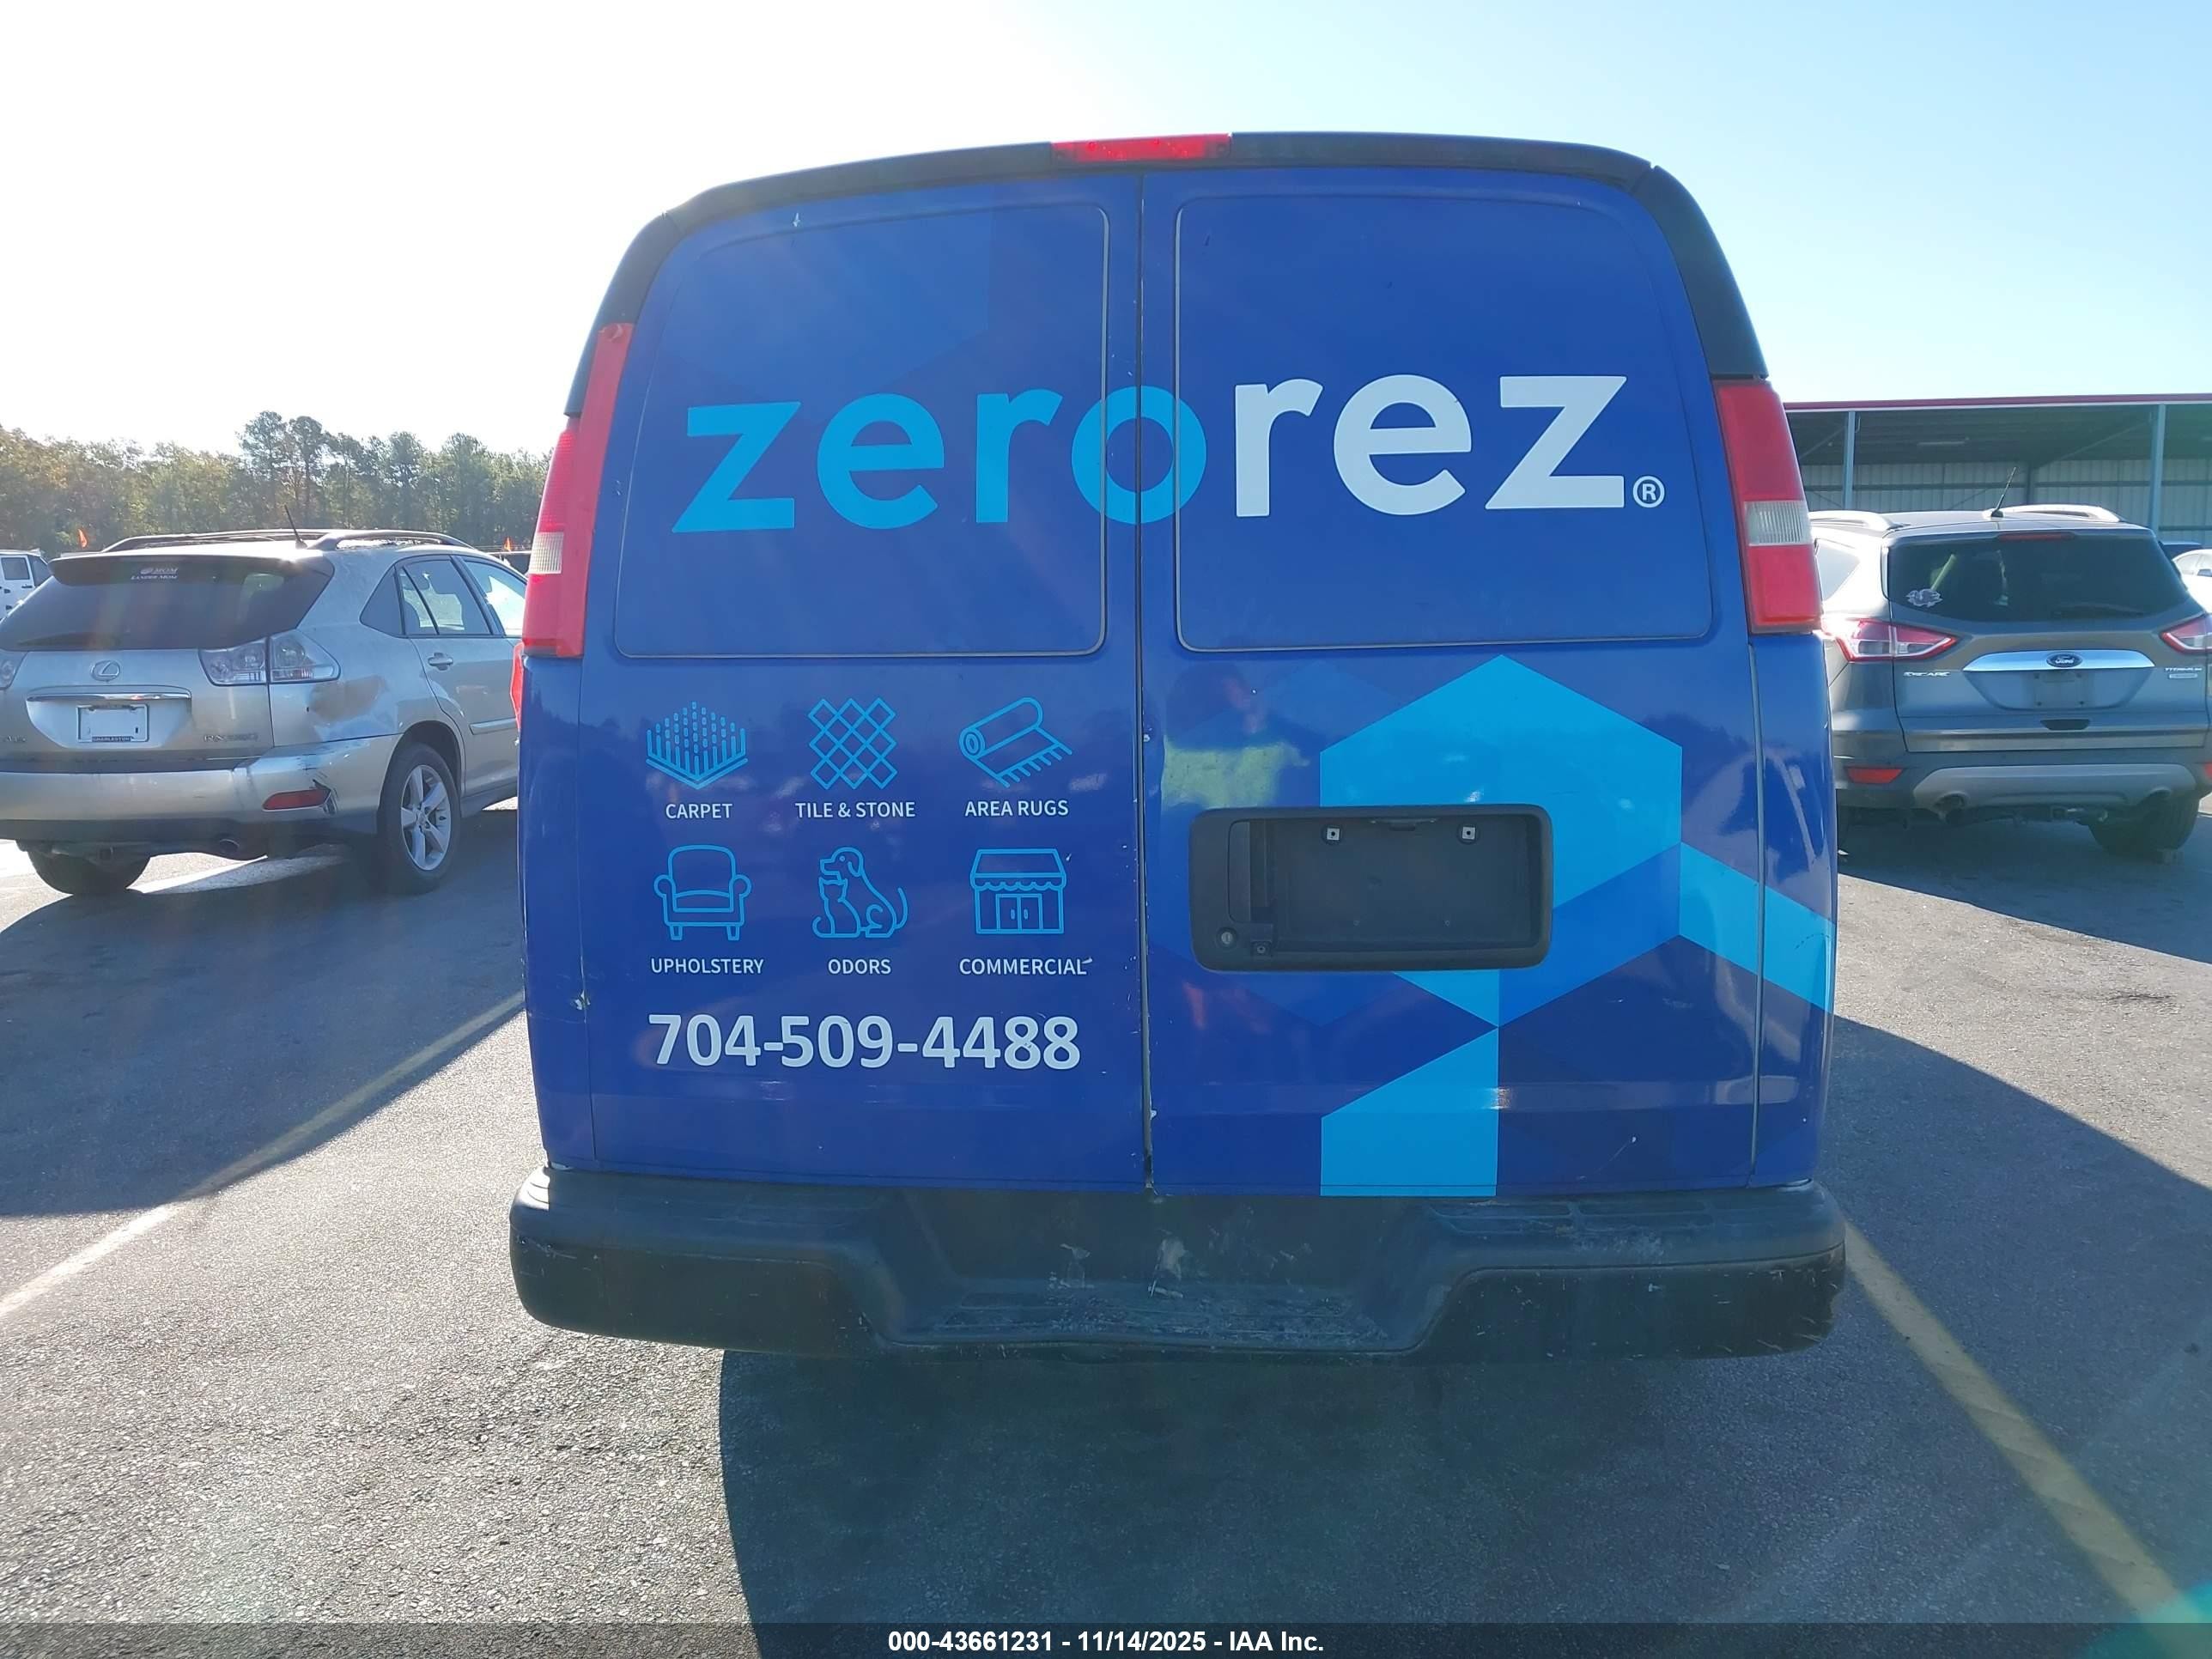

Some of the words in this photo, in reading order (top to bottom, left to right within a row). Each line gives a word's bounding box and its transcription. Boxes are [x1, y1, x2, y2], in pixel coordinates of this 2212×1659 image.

[666, 804, 732, 818] CARPET
[795, 803, 833, 817] TILE
[838, 803, 850, 817] &
[856, 802, 915, 817] STONE
[965, 801, 1012, 816] AREA
[1018, 800, 1067, 815] RUGS
[652, 959, 763, 973] UPHOLSTERY
[829, 959, 890, 974] ODORS
[959, 958, 1087, 976] COMMERCIAL
[649, 1015, 1079, 1069] 704-509-4488
